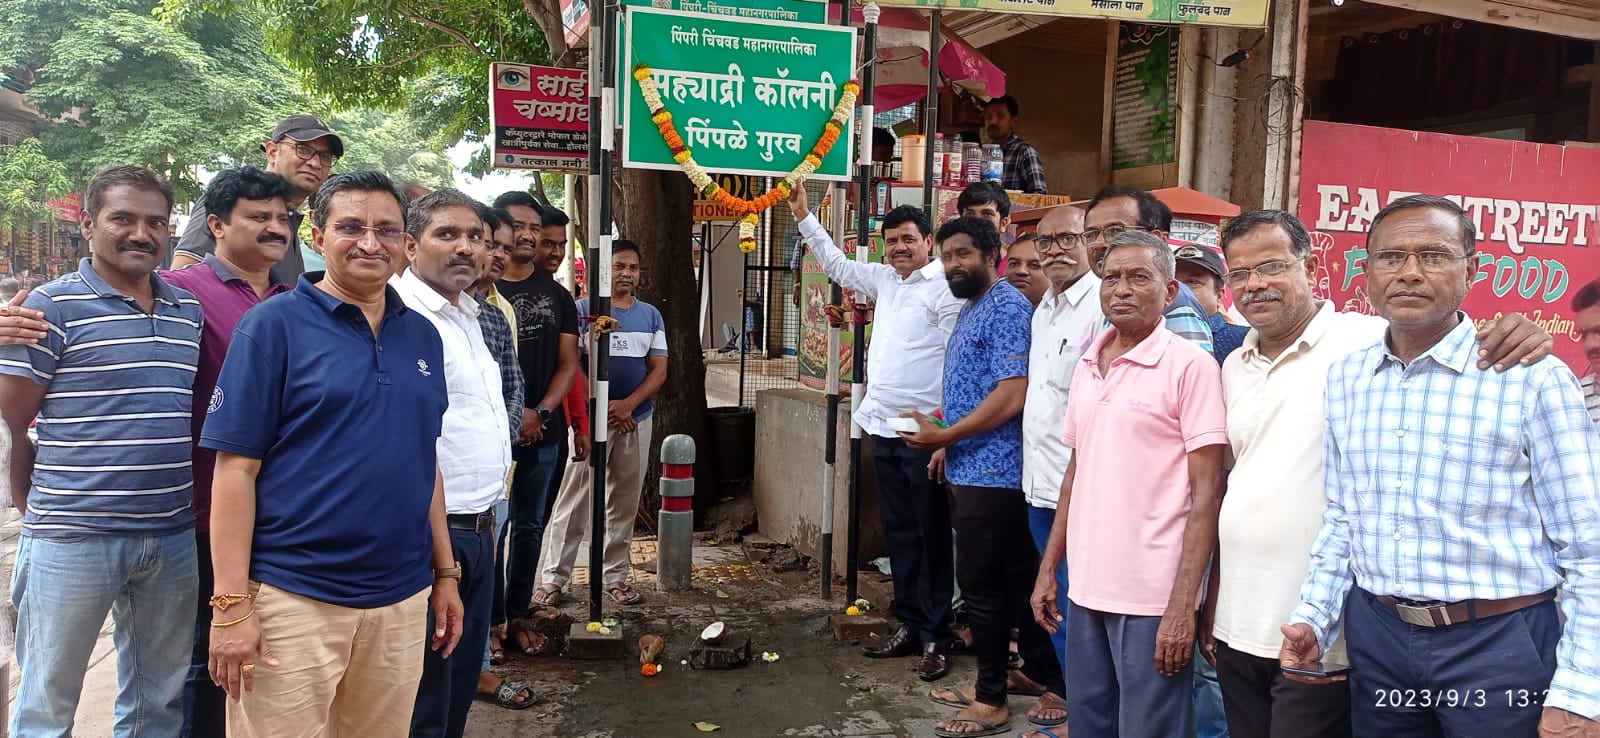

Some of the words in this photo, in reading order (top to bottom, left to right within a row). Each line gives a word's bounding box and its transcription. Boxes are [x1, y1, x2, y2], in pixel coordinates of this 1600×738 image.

[1213, 6, 1231, 16] पान
[670, 25, 698, 47] पिंपरी
[702, 28, 739, 49] चिंचवड
[743, 36, 817, 56] महानगरपालिका
[537, 71, 588, 101] साई
[752, 67, 837, 112] कॉलनी
[513, 99, 589, 123] चष्माघ
[684, 117, 749, 150] पिंपळे
[756, 130, 803, 162] गुरव
[1443, 194, 1596, 254] TREET
